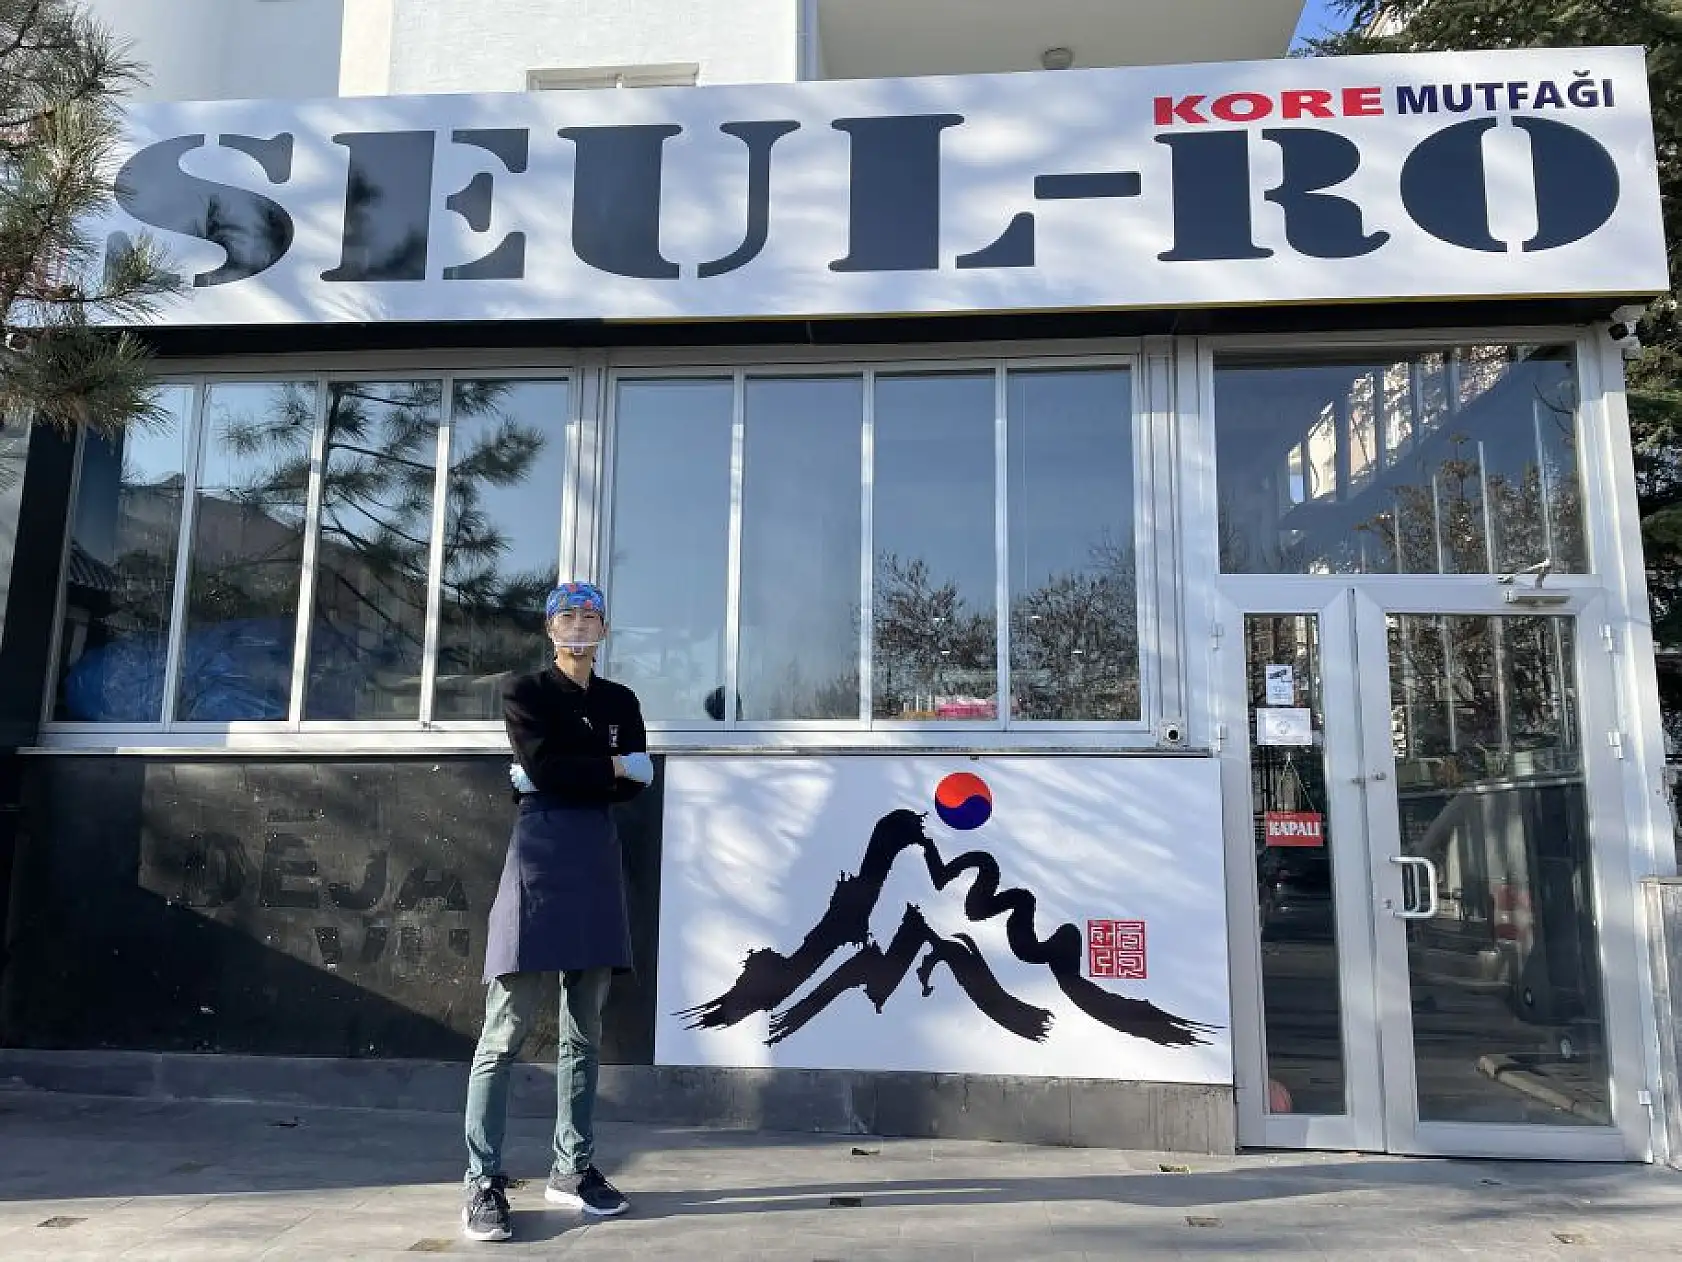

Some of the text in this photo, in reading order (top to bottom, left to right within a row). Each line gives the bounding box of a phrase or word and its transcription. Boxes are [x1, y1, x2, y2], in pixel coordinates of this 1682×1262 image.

[1153, 70, 1615, 126] KORE MUTFAĞI
[103, 114, 1620, 287] SEUL-RO
[1269, 820, 1320, 836] KAPALI
